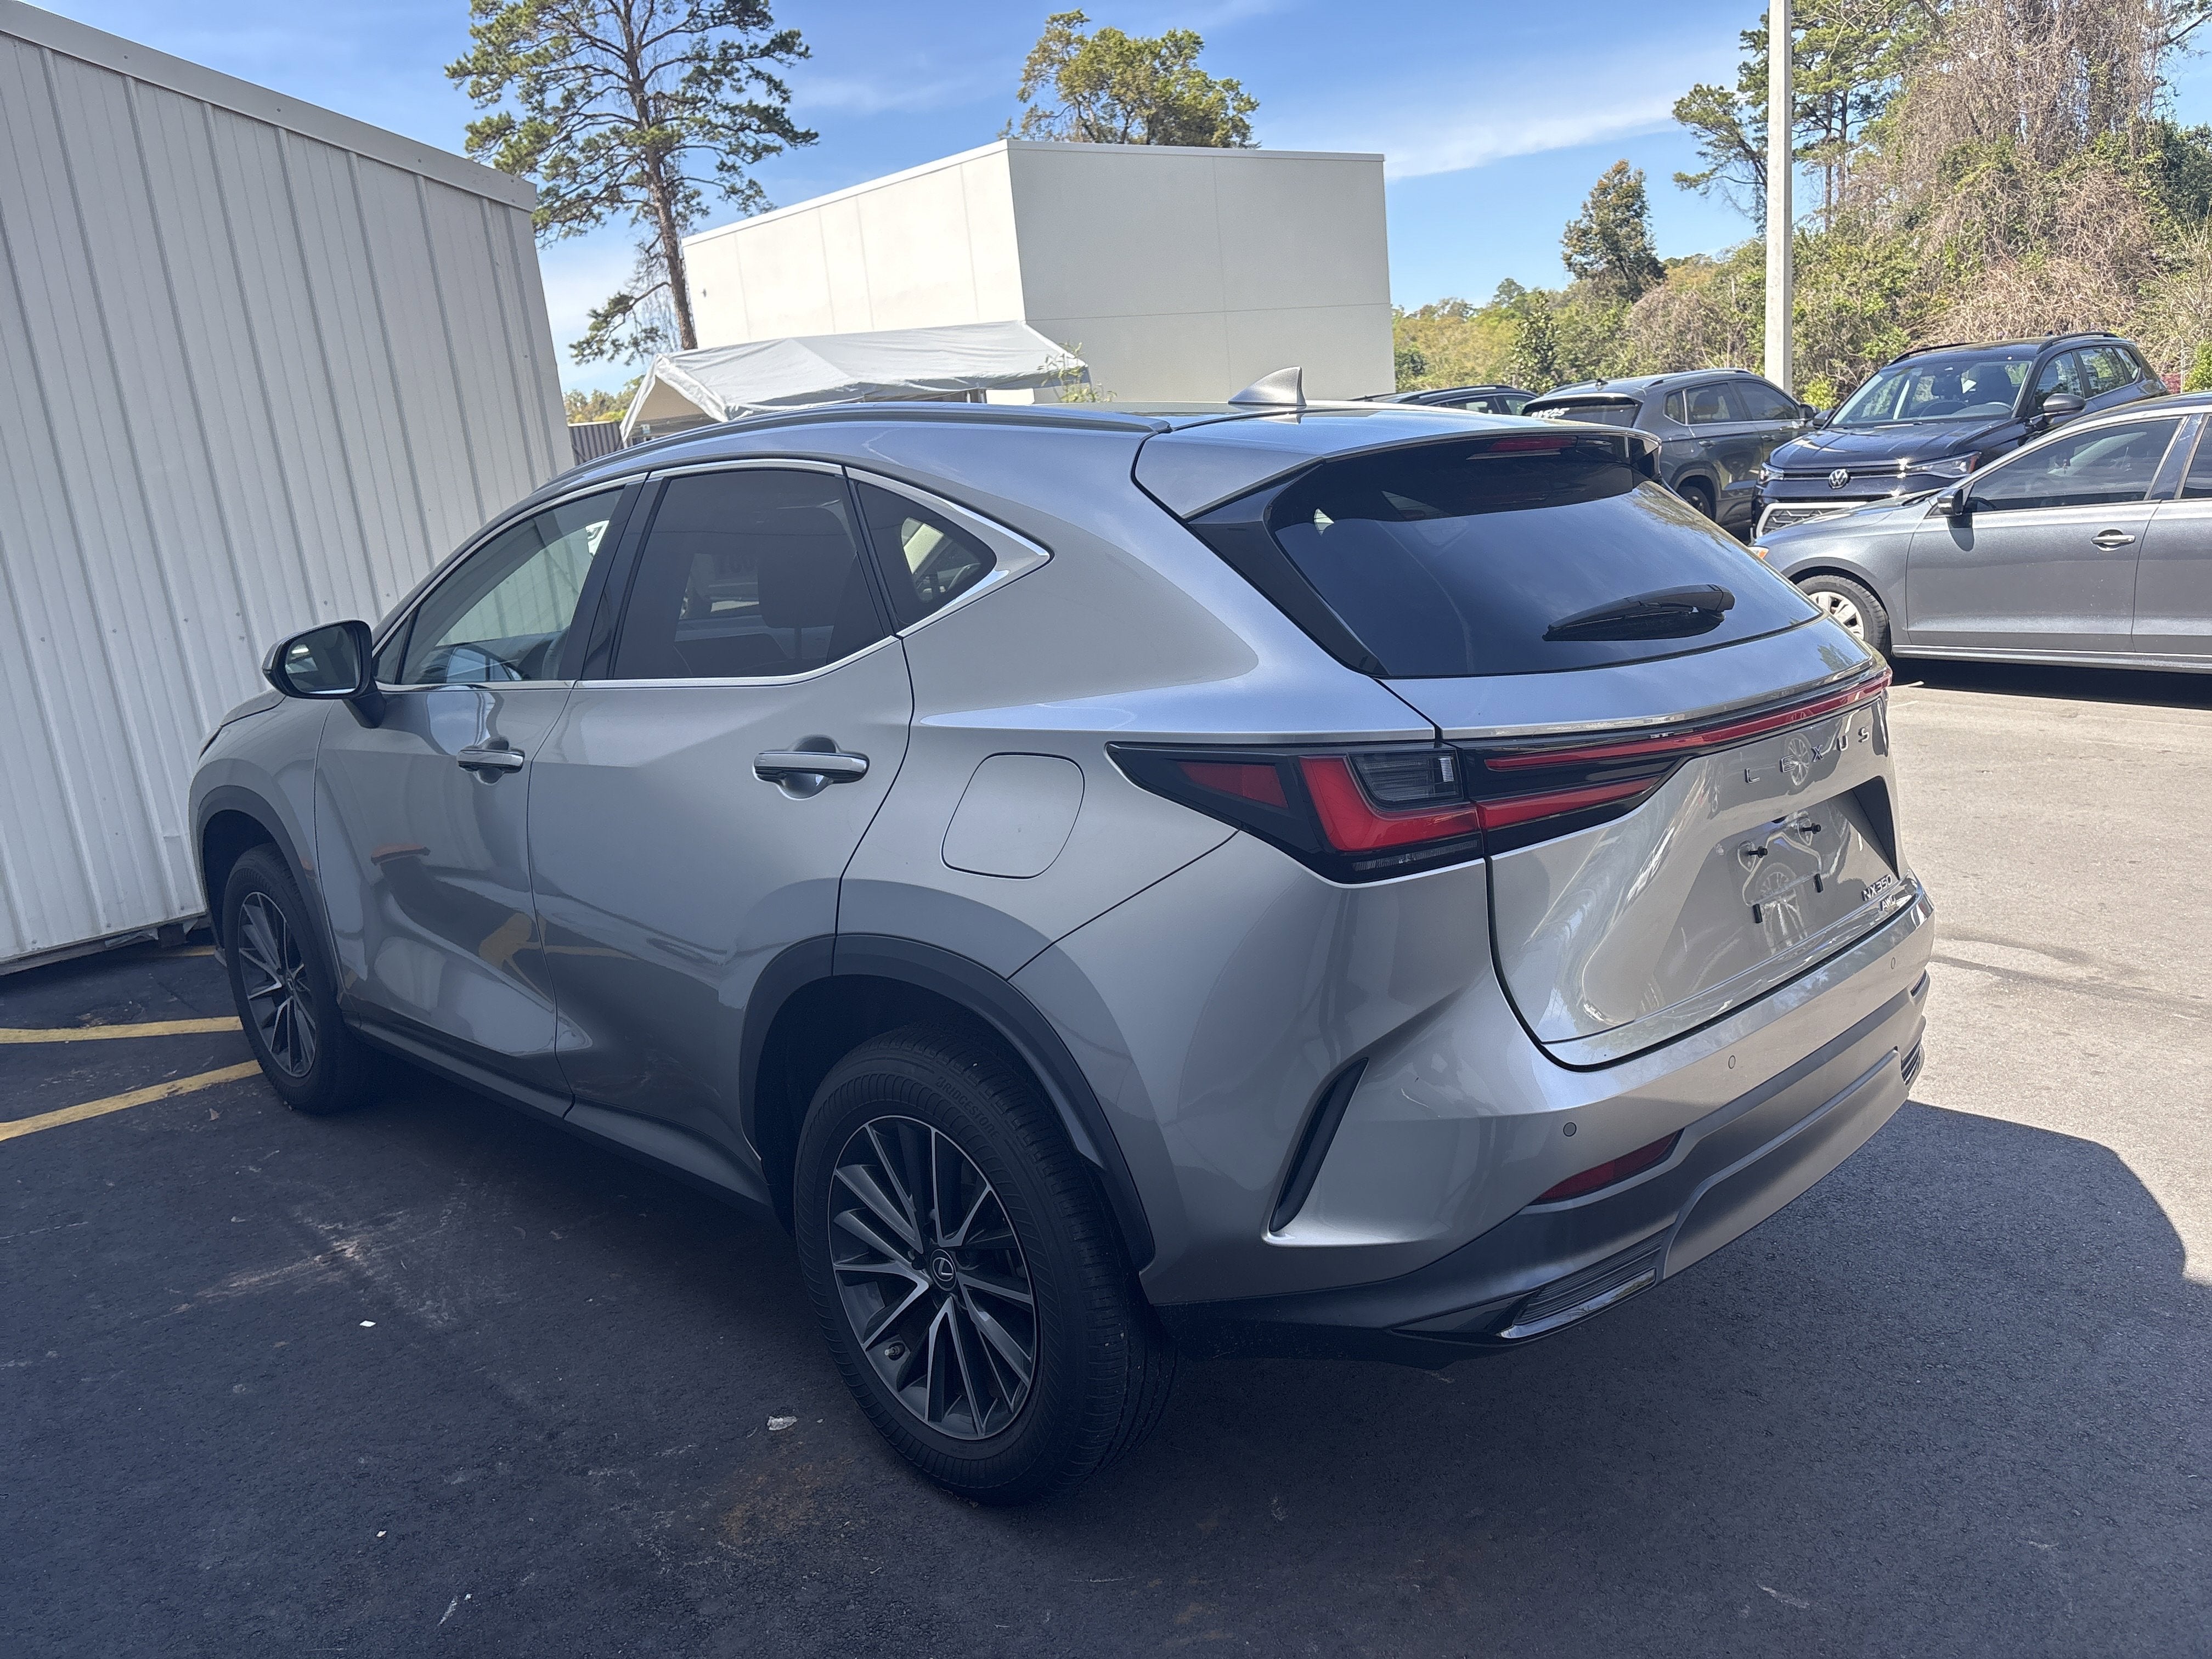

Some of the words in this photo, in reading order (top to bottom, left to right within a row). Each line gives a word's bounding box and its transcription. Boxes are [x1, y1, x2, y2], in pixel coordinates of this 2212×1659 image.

[1745, 726, 1870, 783] LEXUS
[1861, 874, 1892, 901] NX350
[1880, 894, 1896, 911] AWD
[935, 1076, 1000, 1139] BRIDGESTONE
